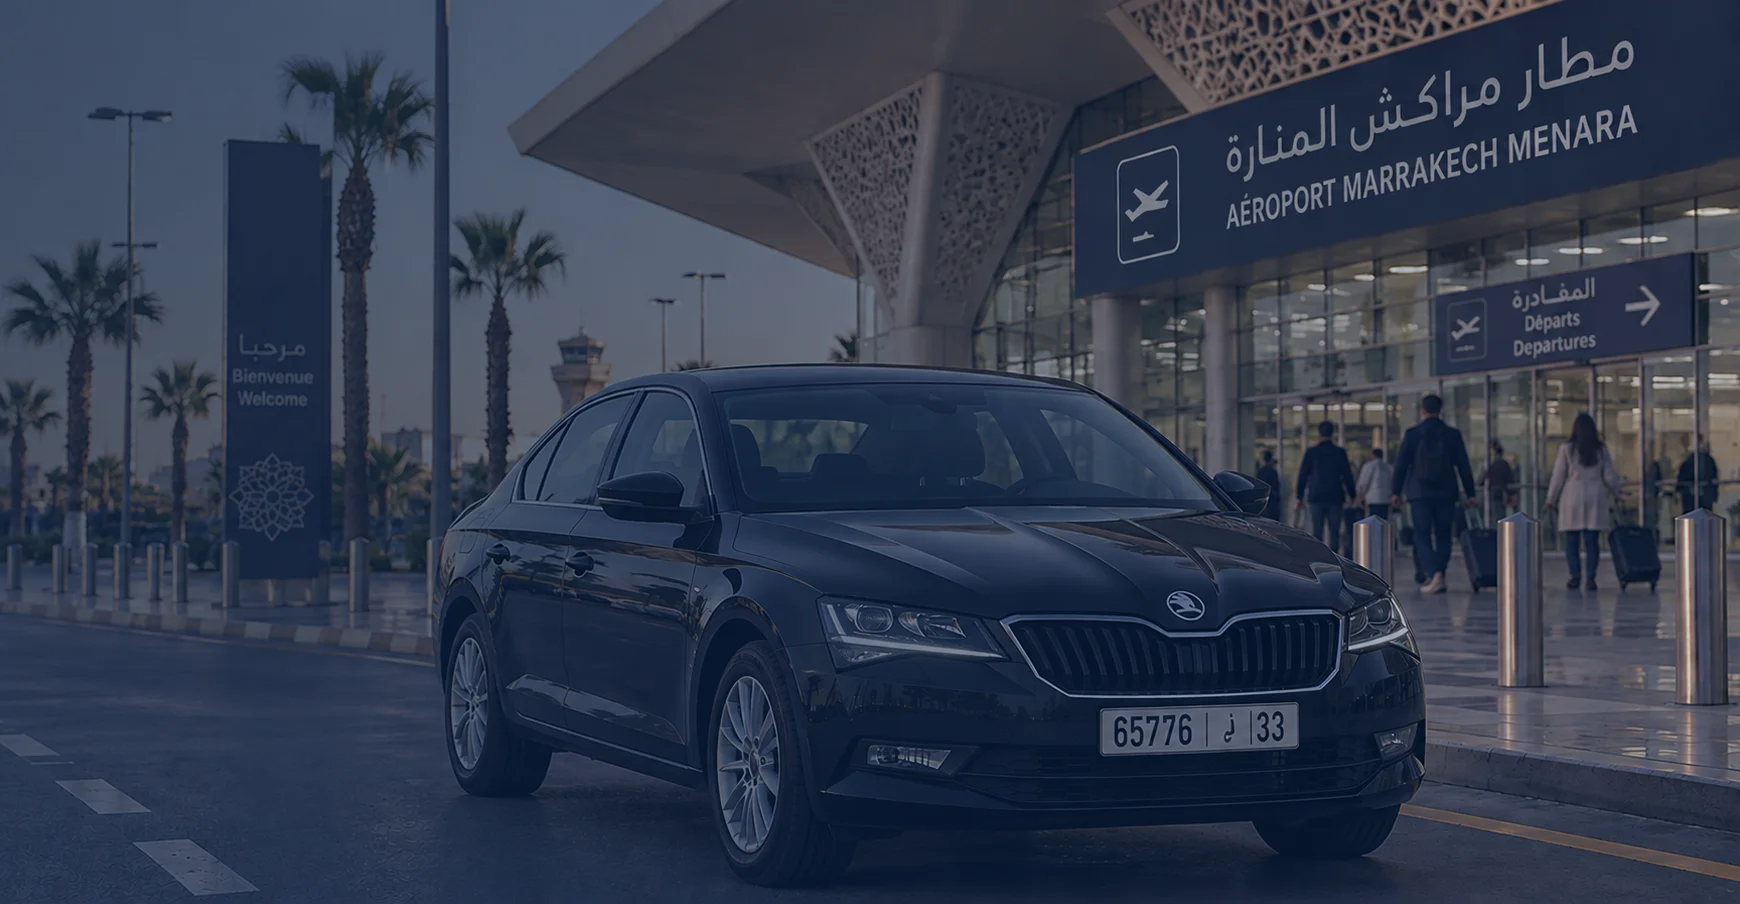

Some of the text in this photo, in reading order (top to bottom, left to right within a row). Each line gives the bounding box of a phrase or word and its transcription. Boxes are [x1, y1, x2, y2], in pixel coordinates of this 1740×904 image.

[1225, 36, 1635, 182] مطار مراكش المنارة
[1226, 104, 1639, 231] AÉROPORT MARRAKECH MENARA
[1512, 277, 1595, 312] المغادرة
[1525, 311, 1581, 334] Départs
[239, 333, 306, 362] مرحبا
[1513, 334, 1597, 359] Departures
[232, 368, 314, 385] Bienvenue
[237, 390, 308, 407] Welcome
[1113, 713, 1193, 748] 65776
[1256, 710, 1285, 743] 33
